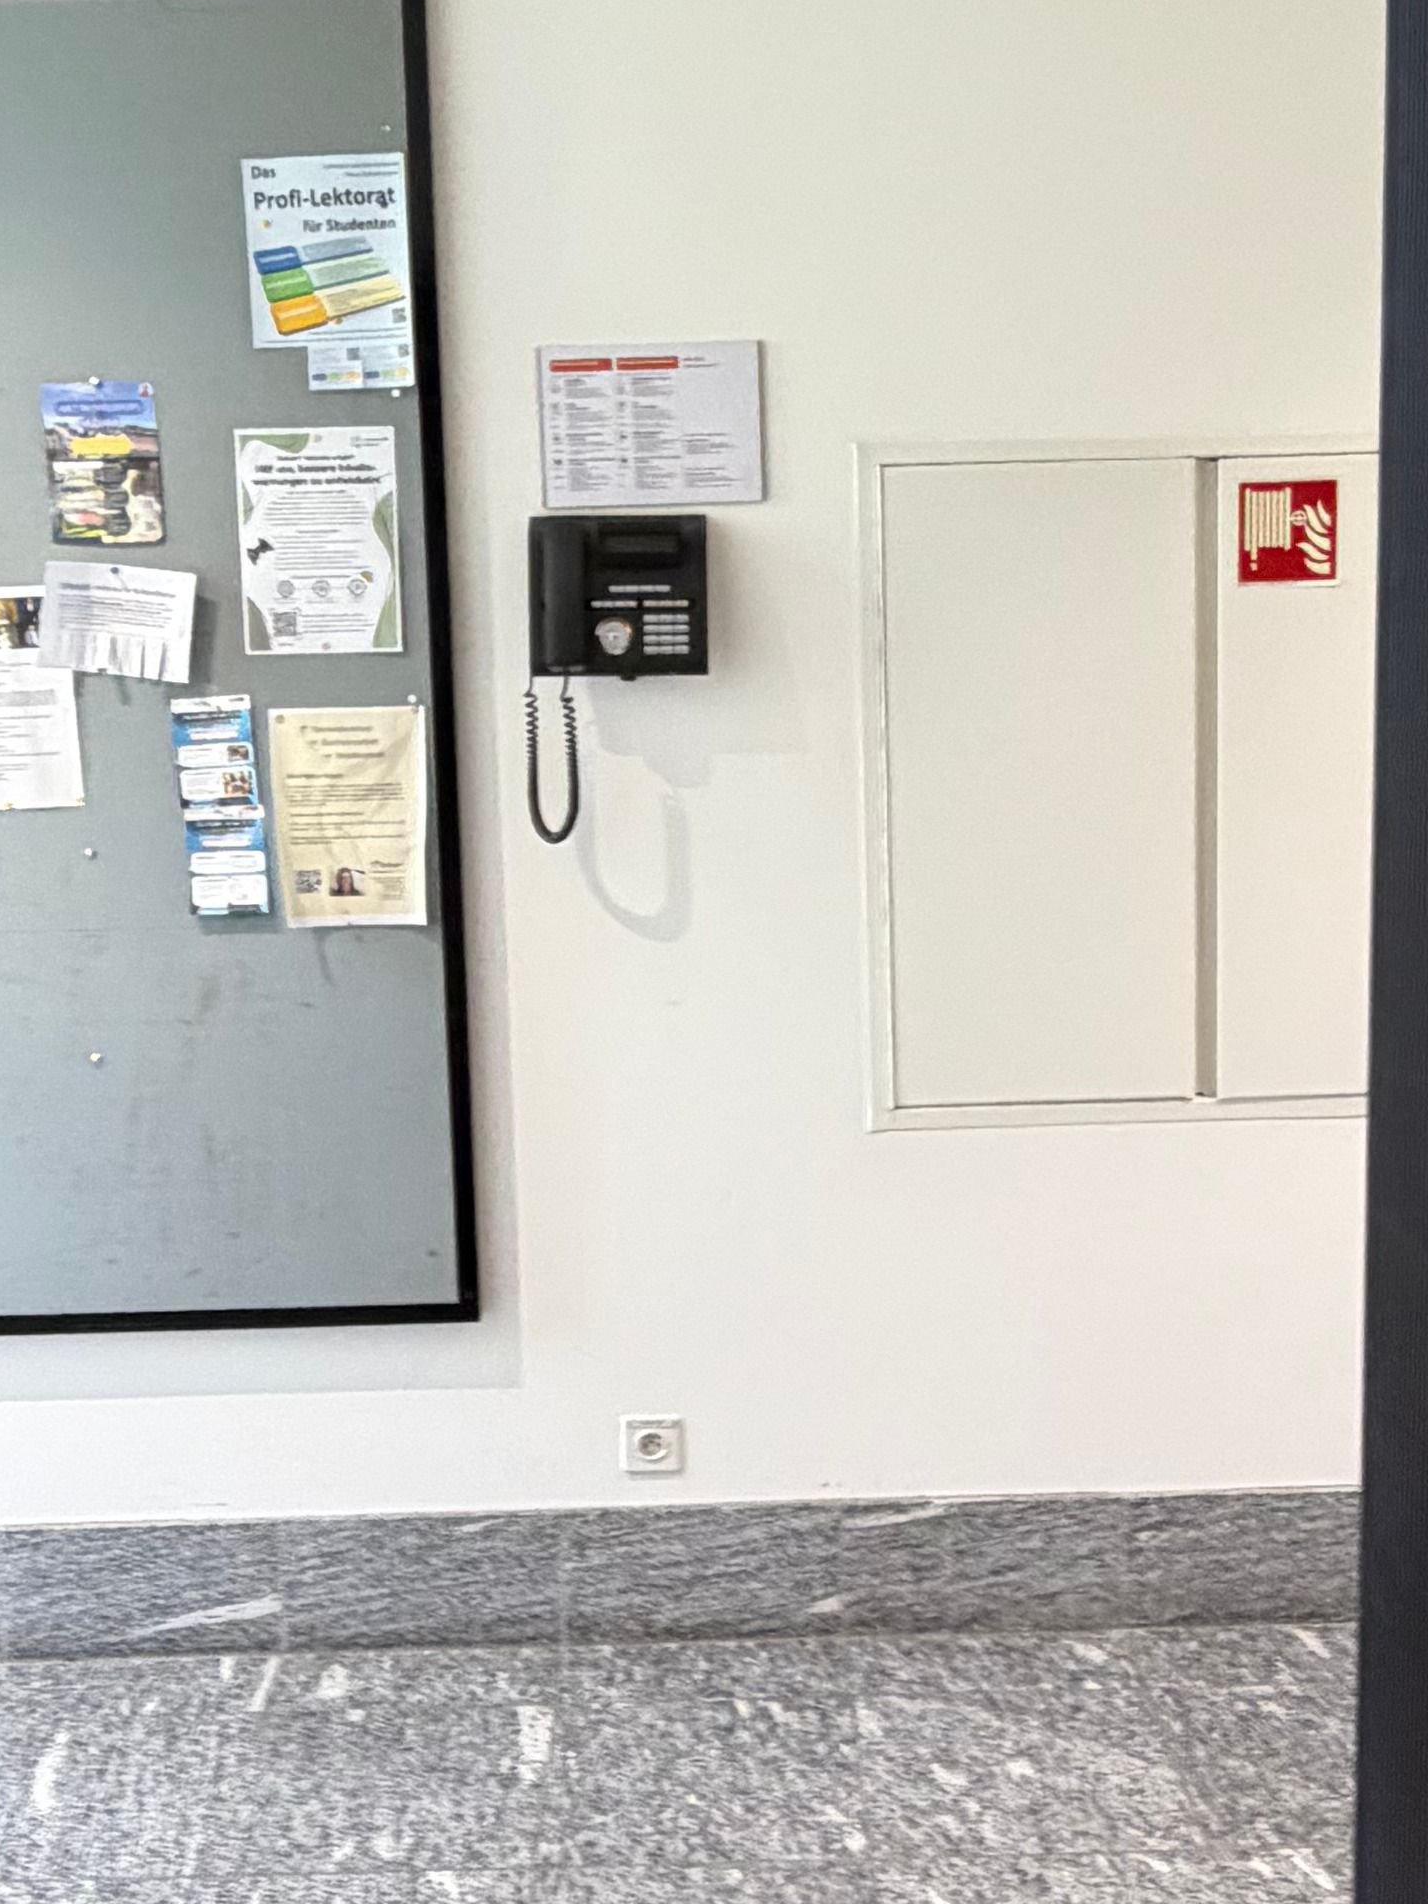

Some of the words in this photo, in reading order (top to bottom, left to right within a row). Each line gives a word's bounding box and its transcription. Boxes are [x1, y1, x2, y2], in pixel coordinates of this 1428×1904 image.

[251, 166, 276, 179] Das
[254, 187, 397, 209] Profi-Lektorat
[326, 217, 396, 232] Studenten
